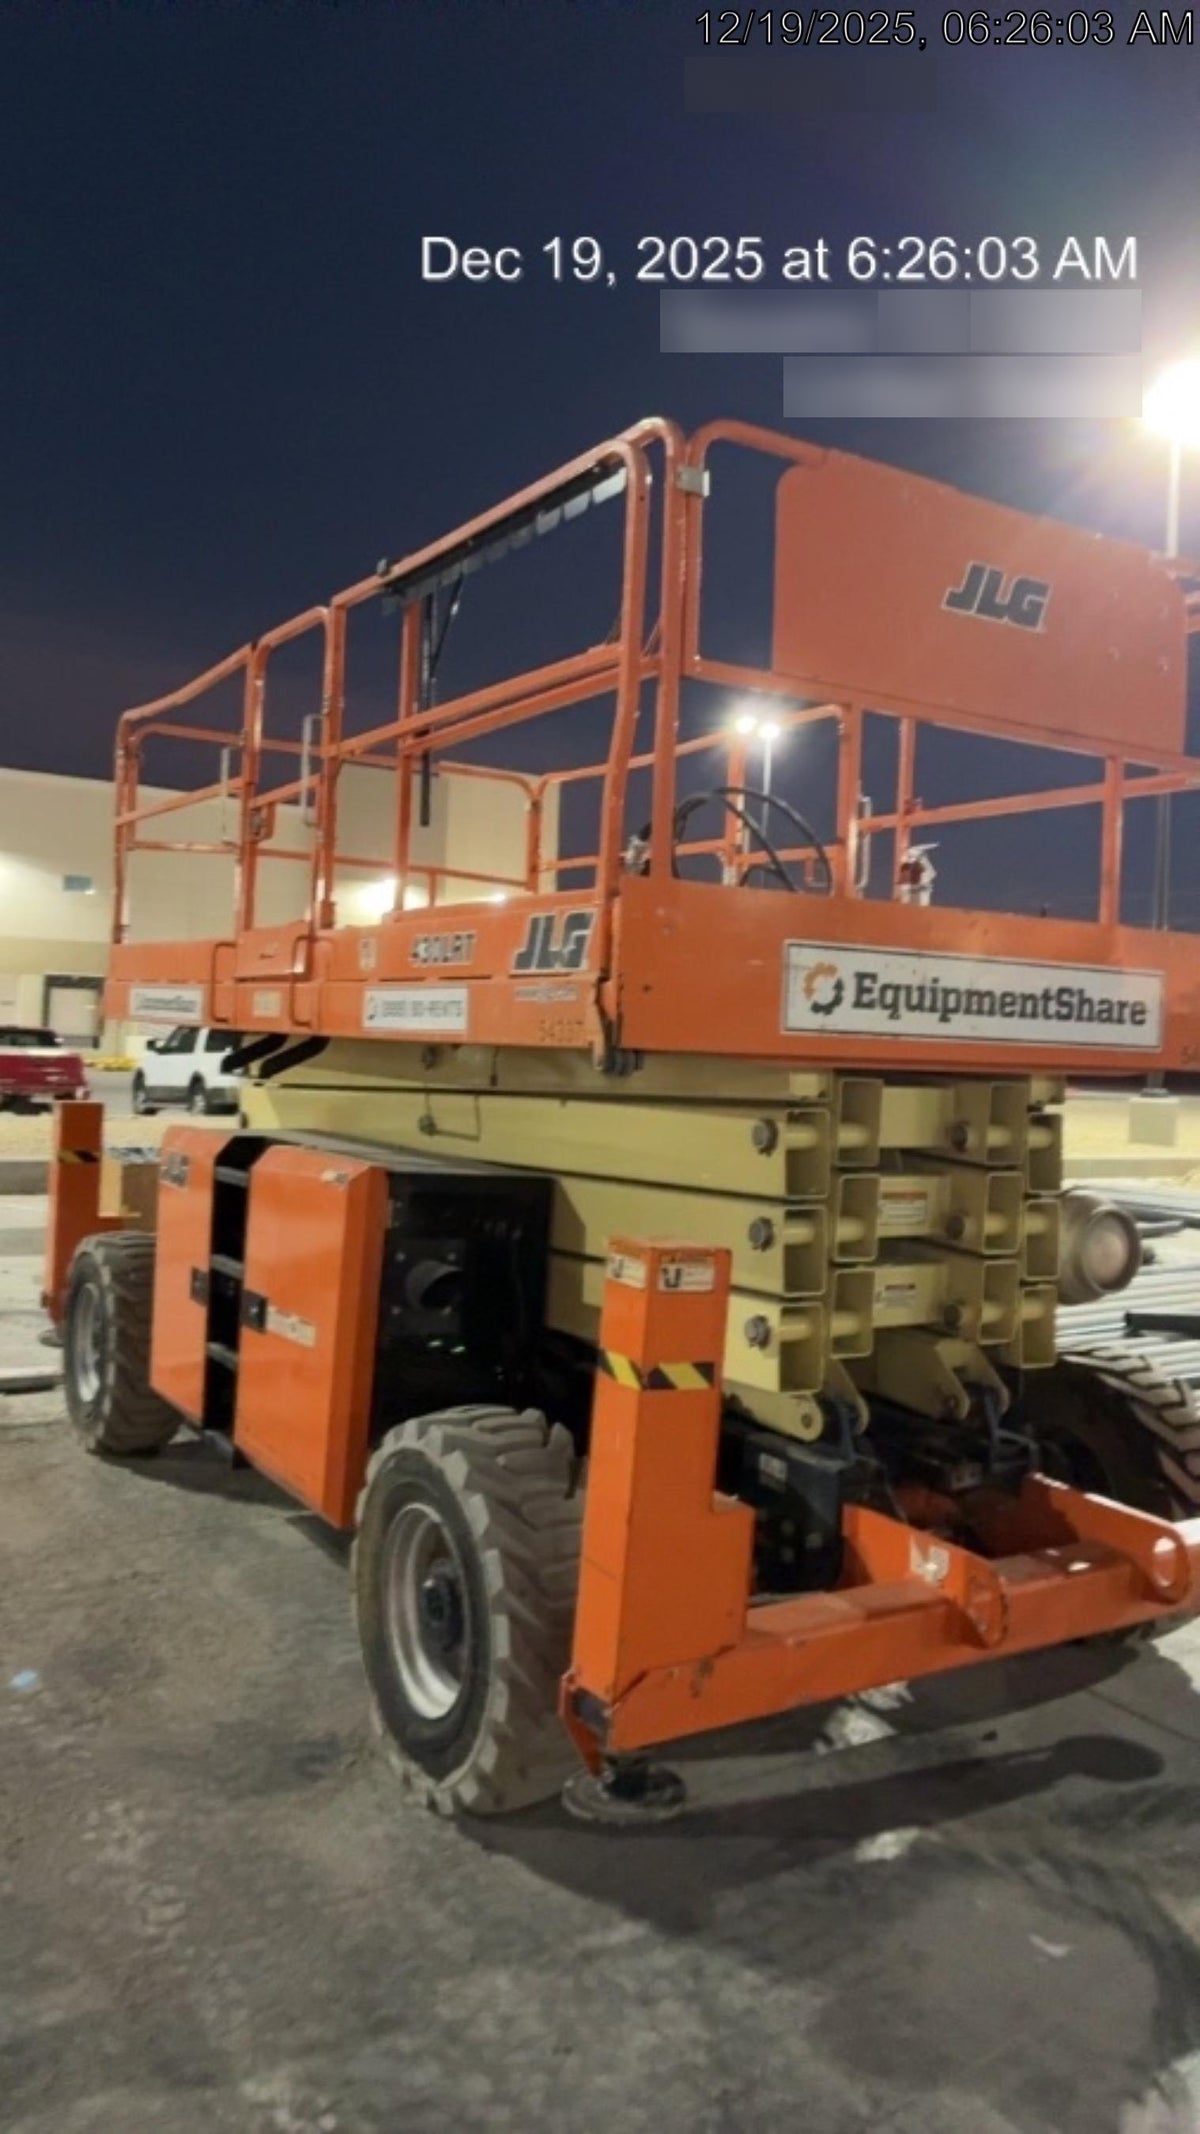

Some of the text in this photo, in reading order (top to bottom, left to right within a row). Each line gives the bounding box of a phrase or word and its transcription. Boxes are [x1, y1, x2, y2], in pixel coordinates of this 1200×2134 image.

[942, 563, 1051, 632] JLG
[512, 908, 597, 973] JLG
[853, 971, 1147, 1026] EquipmentShare
